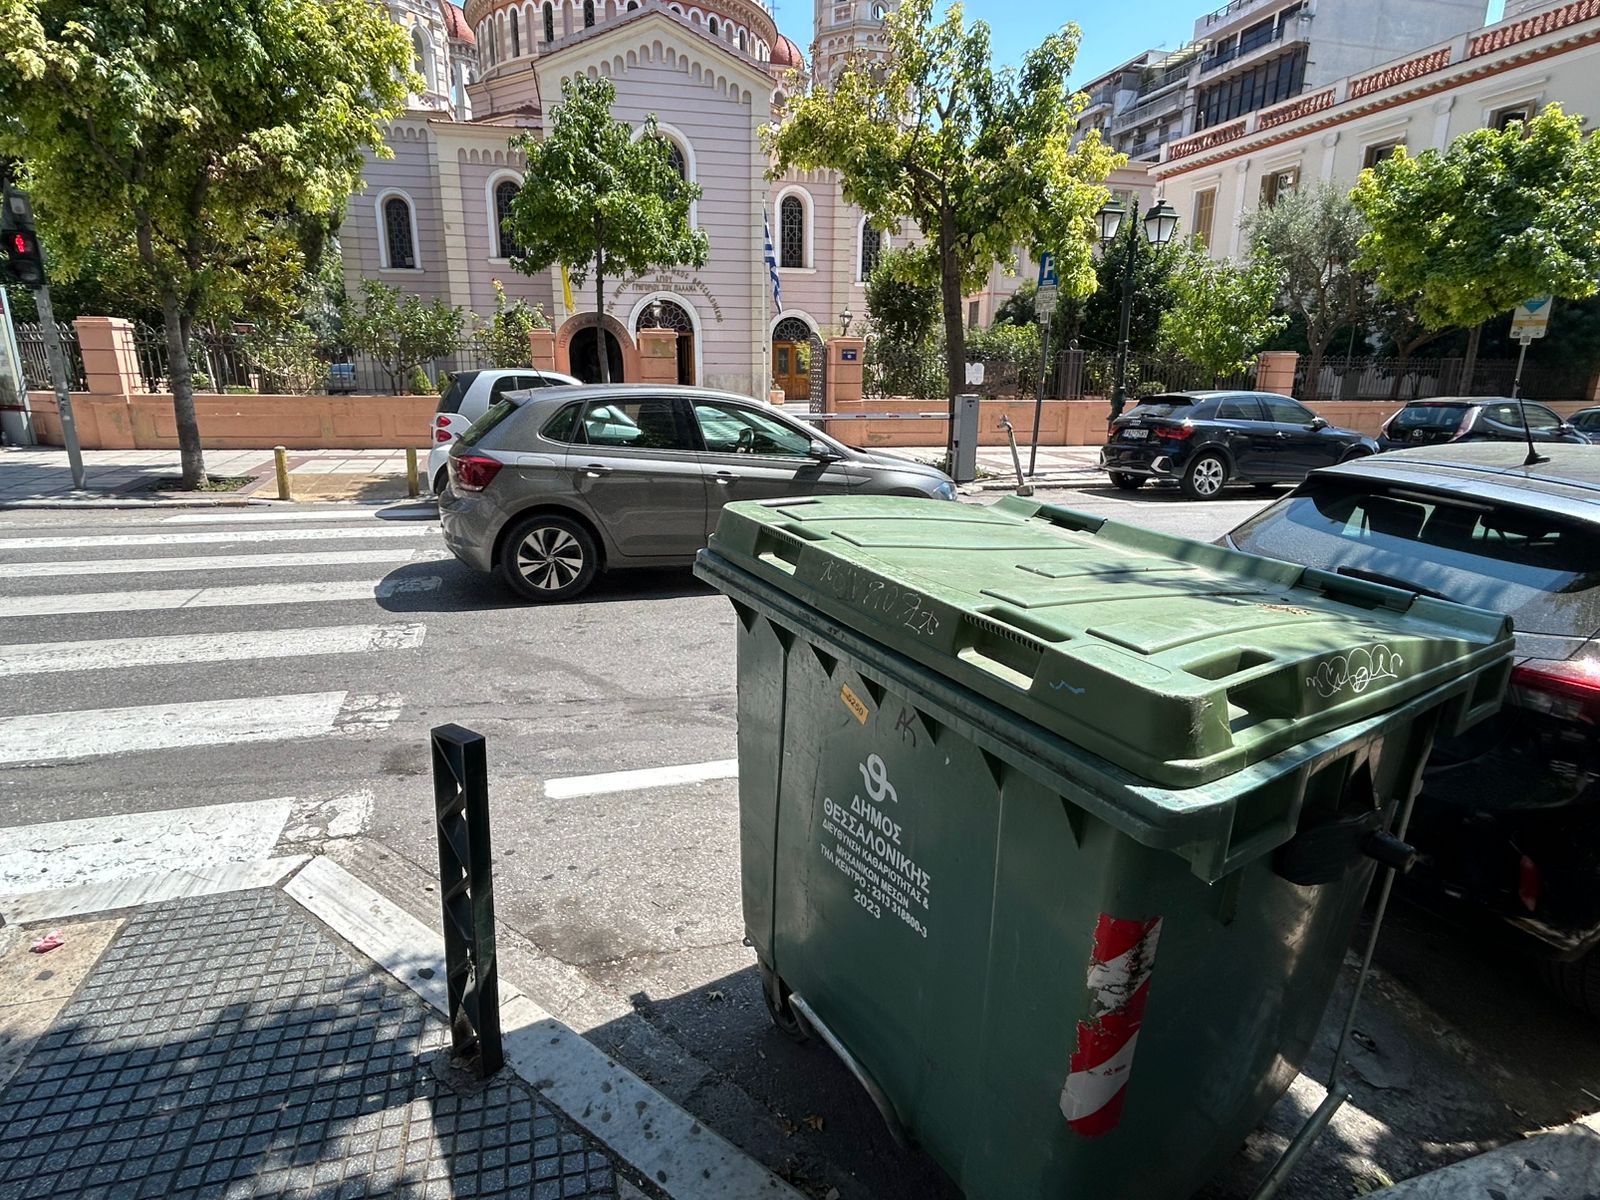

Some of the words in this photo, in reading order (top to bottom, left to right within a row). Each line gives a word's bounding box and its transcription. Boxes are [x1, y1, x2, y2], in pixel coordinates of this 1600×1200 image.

[823, 797, 931, 894] ΘΕΣΣΑΛΟΝΙΚΗΣ
[851, 794, 902, 845] ΔΗΜΟΣ
[820, 843, 834, 863] ΤΗΛ
[835, 855, 867, 888] ΚΕΝΤΡΟ
[872, 885, 891, 908] 2313
[891, 901, 928, 938] 318800-3
[822, 818, 861, 855] ΔΙΕΥΘΥΝΣΗ
[862, 848, 922, 903] ΚΑΘΑΡΙΟΤΗΤΑΣ
[922, 897, 929, 910] &
[836, 843, 880, 886] ΜΗΧΑΝΙΚΩΝ
[880, 878, 909, 909] ΜΕΣΩΝ
[853, 888, 881, 919] 2023
